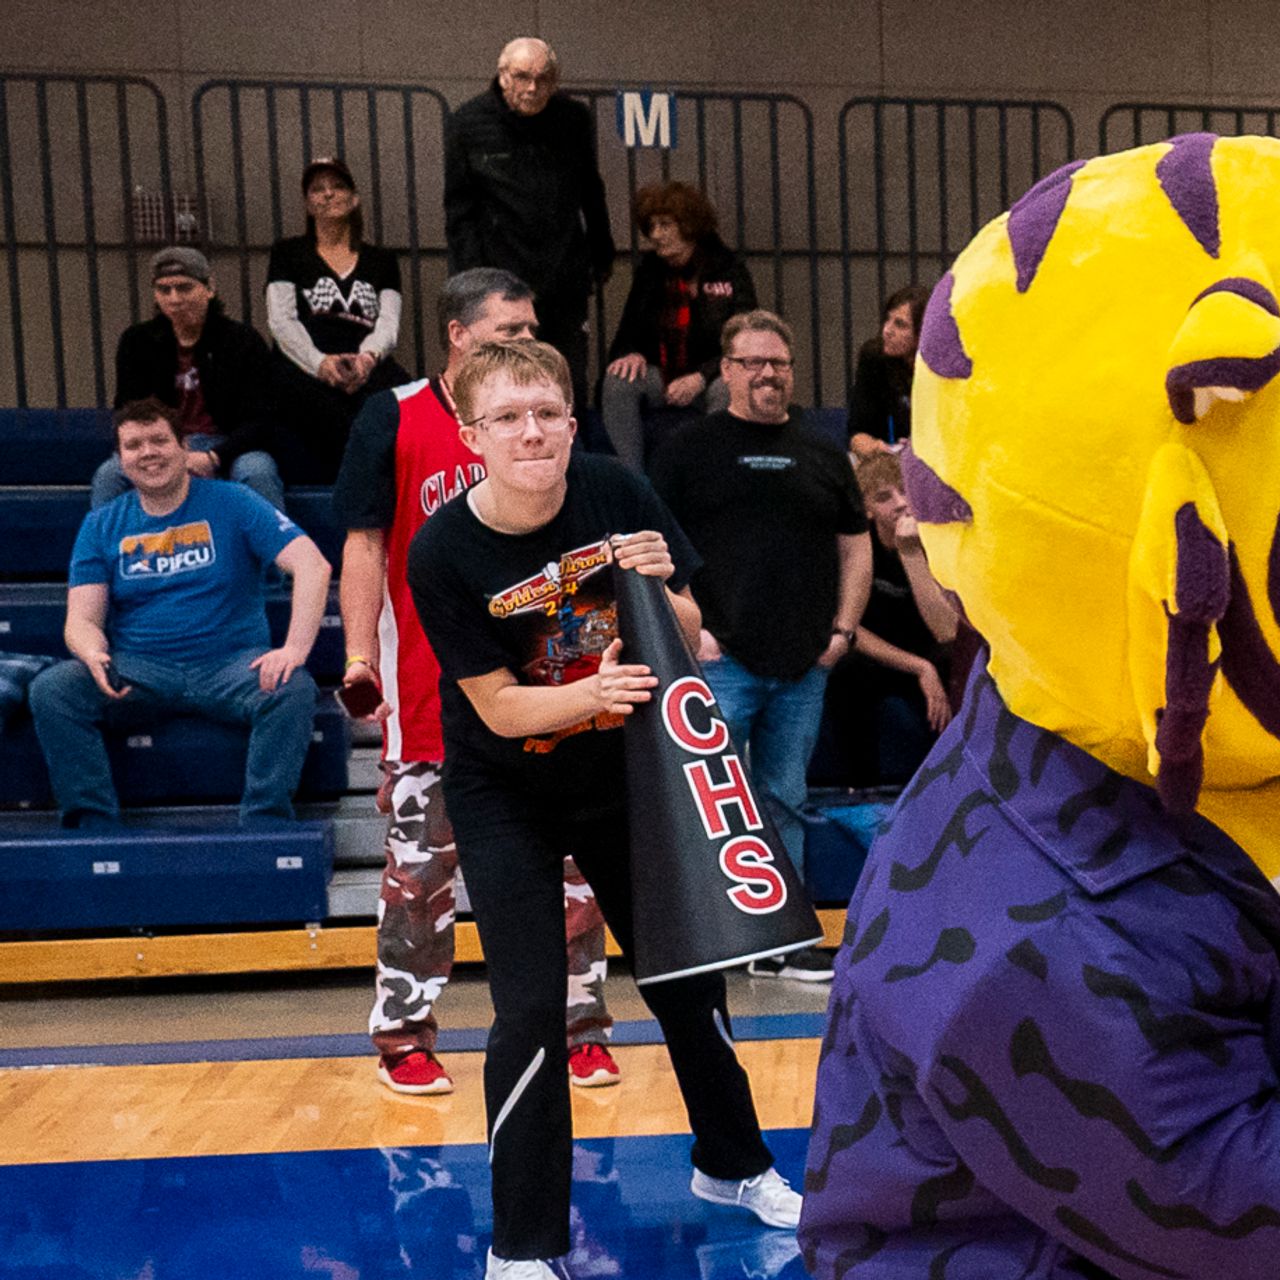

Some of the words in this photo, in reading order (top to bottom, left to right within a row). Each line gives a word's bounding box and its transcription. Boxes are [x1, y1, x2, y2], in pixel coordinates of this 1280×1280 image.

[623, 91, 670, 147] M
[488, 581, 559, 619] Golden
[661, 675, 788, 915] CHS
